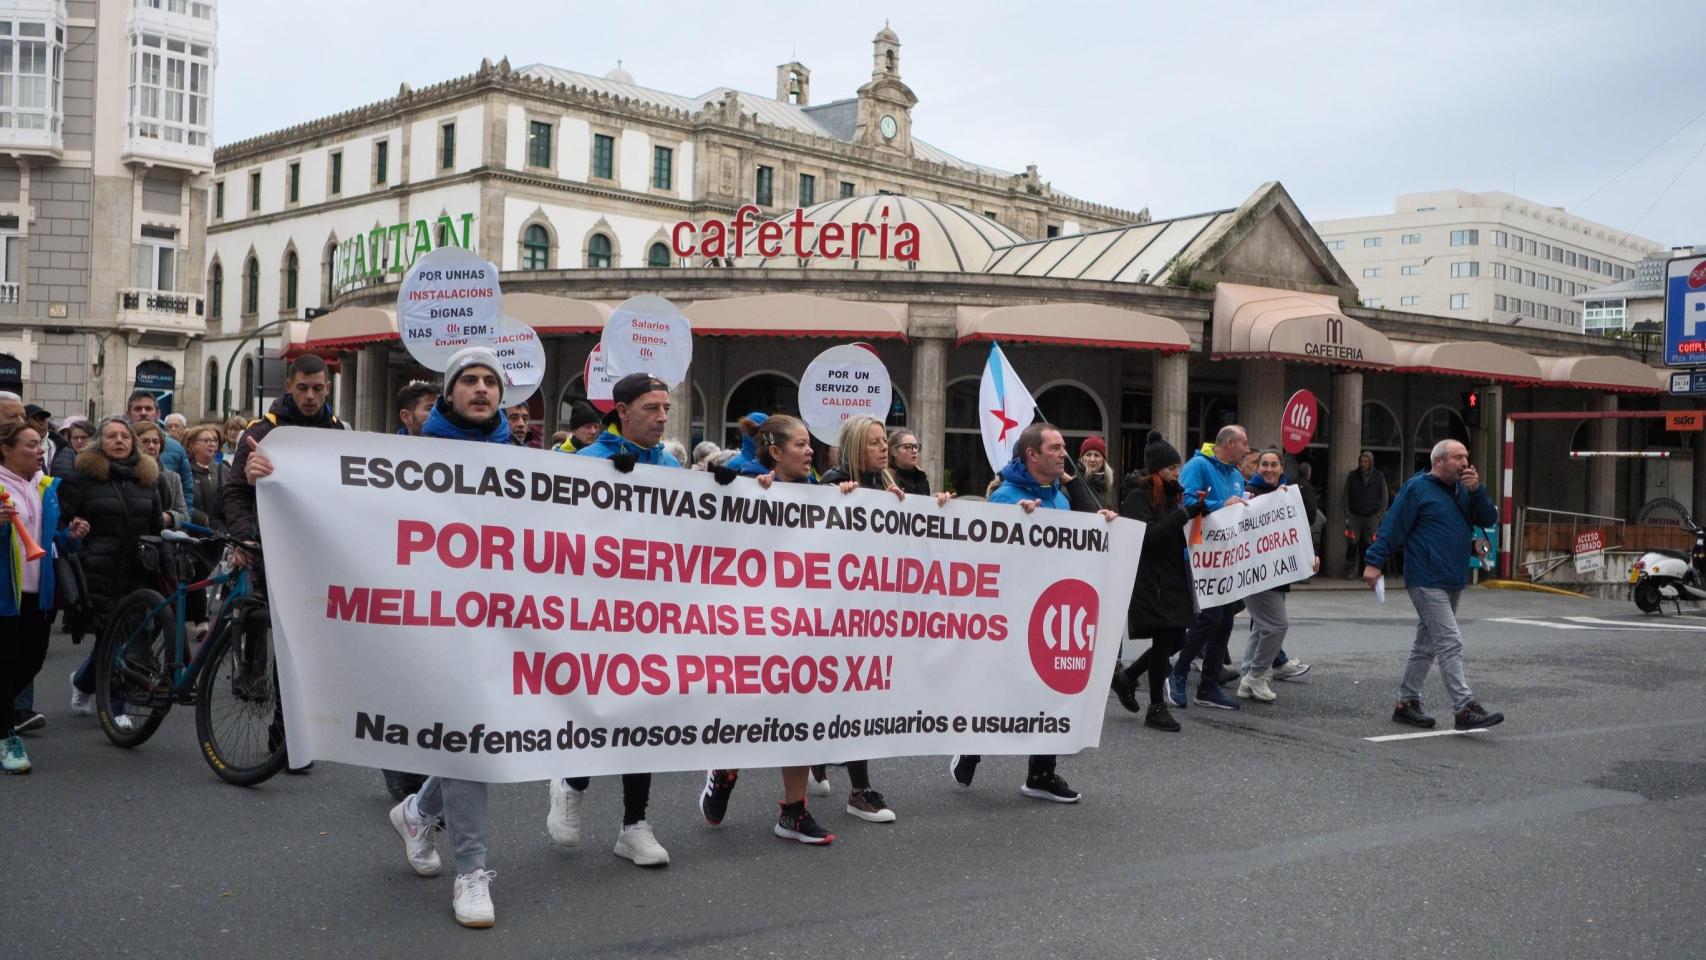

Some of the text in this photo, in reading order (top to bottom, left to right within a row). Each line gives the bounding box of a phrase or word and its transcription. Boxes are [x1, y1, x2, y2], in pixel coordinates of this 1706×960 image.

[419, 269, 485, 281] POR UNHAS
[409, 286, 494, 301] INSTALACIÓNS
[430, 307, 474, 319] DIGNAS
[408, 327, 432, 339] NAS
[463, 325, 487, 336] EDM
[631, 319, 671, 332] Salarios
[632, 333, 667, 345] Dignos.
[1305, 343, 1363, 360] CAFETERIA
[1679, 341, 1706, 353] COMPL
[828, 370, 869, 380] POR UN
[815, 383, 880, 393] SERVIZO DE
[822, 397, 871, 407] CALIDADE
[340, 455, 1109, 553] ESCOLAS DEPORTIVAS MUNICIPAIS CONCELLO DA CORUÑA
[1256, 528, 1299, 554] COBRAR
[1577, 532, 1599, 543] ACCESO
[1575, 540, 1602, 553] CERRADO
[397, 519, 1000, 598] POR UN SERVIZO DE CALIDADE
[1238, 564, 1267, 589] DIGNO
[326, 585, 1008, 641] MELLORAS LABORAIS E SALARIOS DIGNOS
[1043, 604, 1096, 652] CIG
[1054, 656, 1087, 671] ENSINO
[513, 651, 893, 696] NOVOS PREGOS XA!
[355, 710, 1071, 754] Na defensa dos nosos dereitos e dos usuarios e usuarias
